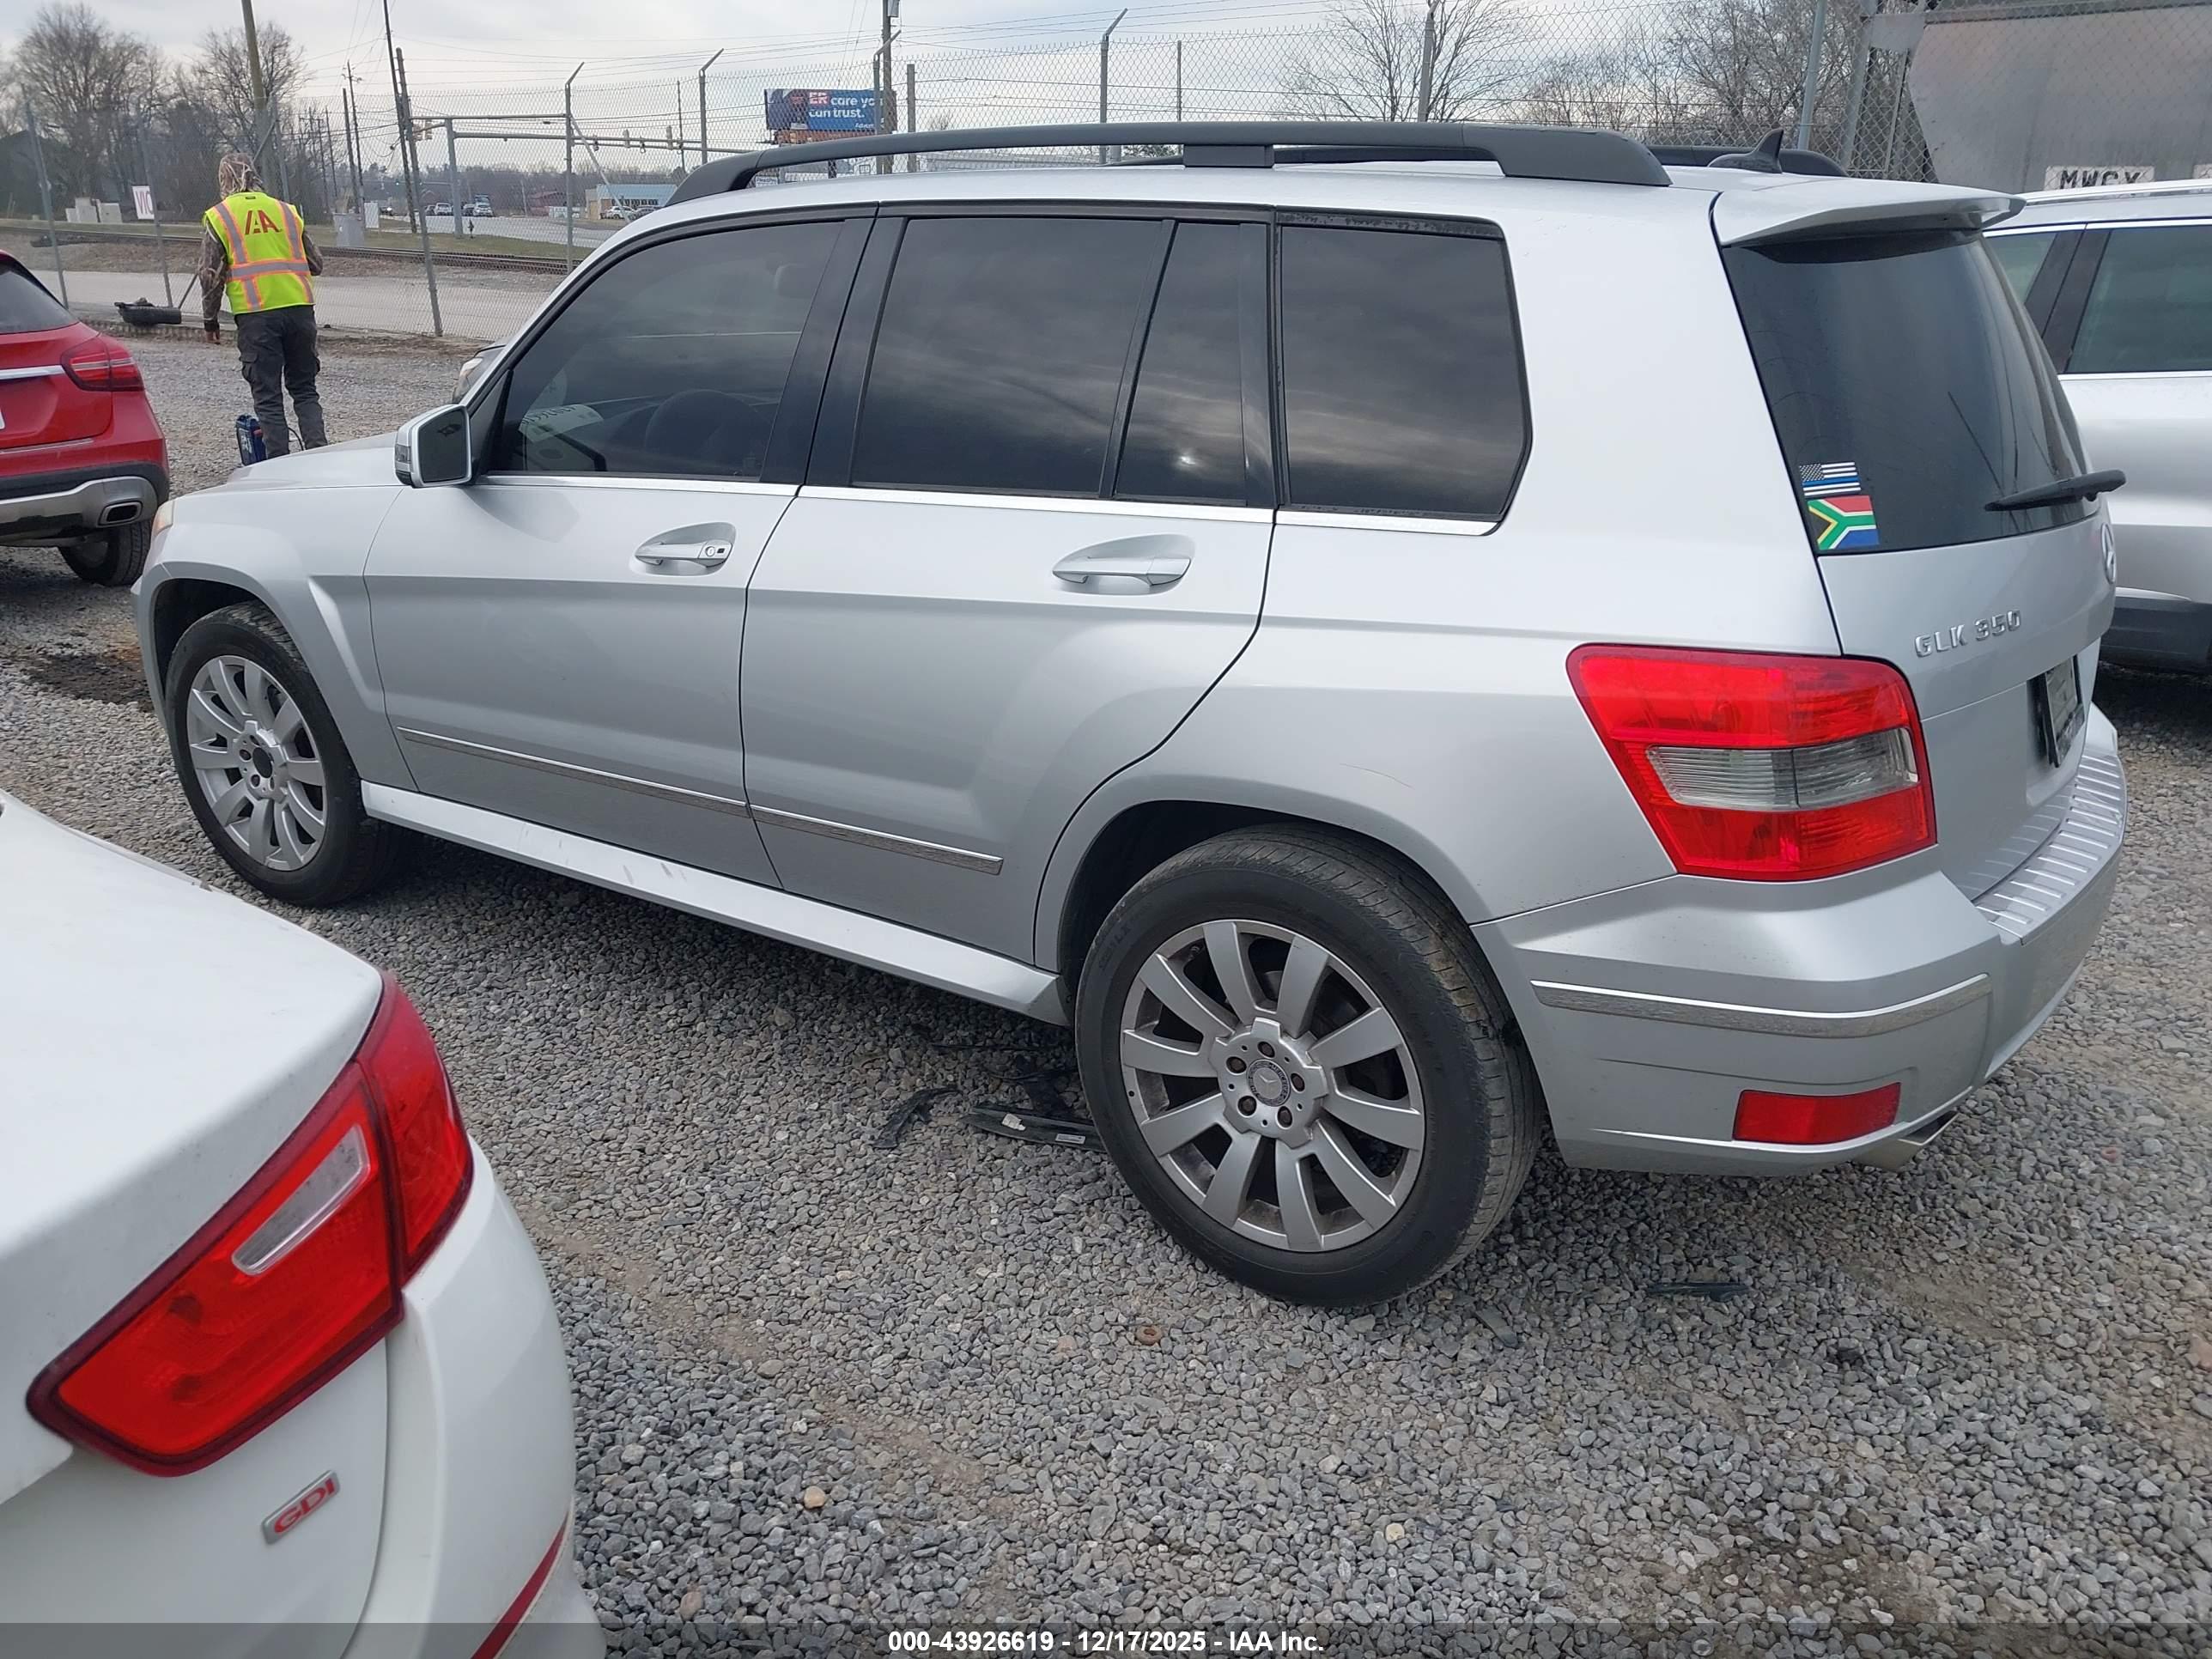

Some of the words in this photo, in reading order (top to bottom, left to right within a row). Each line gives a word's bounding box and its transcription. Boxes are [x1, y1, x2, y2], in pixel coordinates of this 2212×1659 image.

[809, 92, 828, 104] ER
[831, 96, 858, 106] care
[861, 96, 883, 108] yo
[809, 108, 830, 118] can
[833, 107, 865, 118] trust.
[1914, 624, 1967, 658] GLK
[1974, 609, 2021, 641] 350
[274, 1477, 336, 1534] GDI
